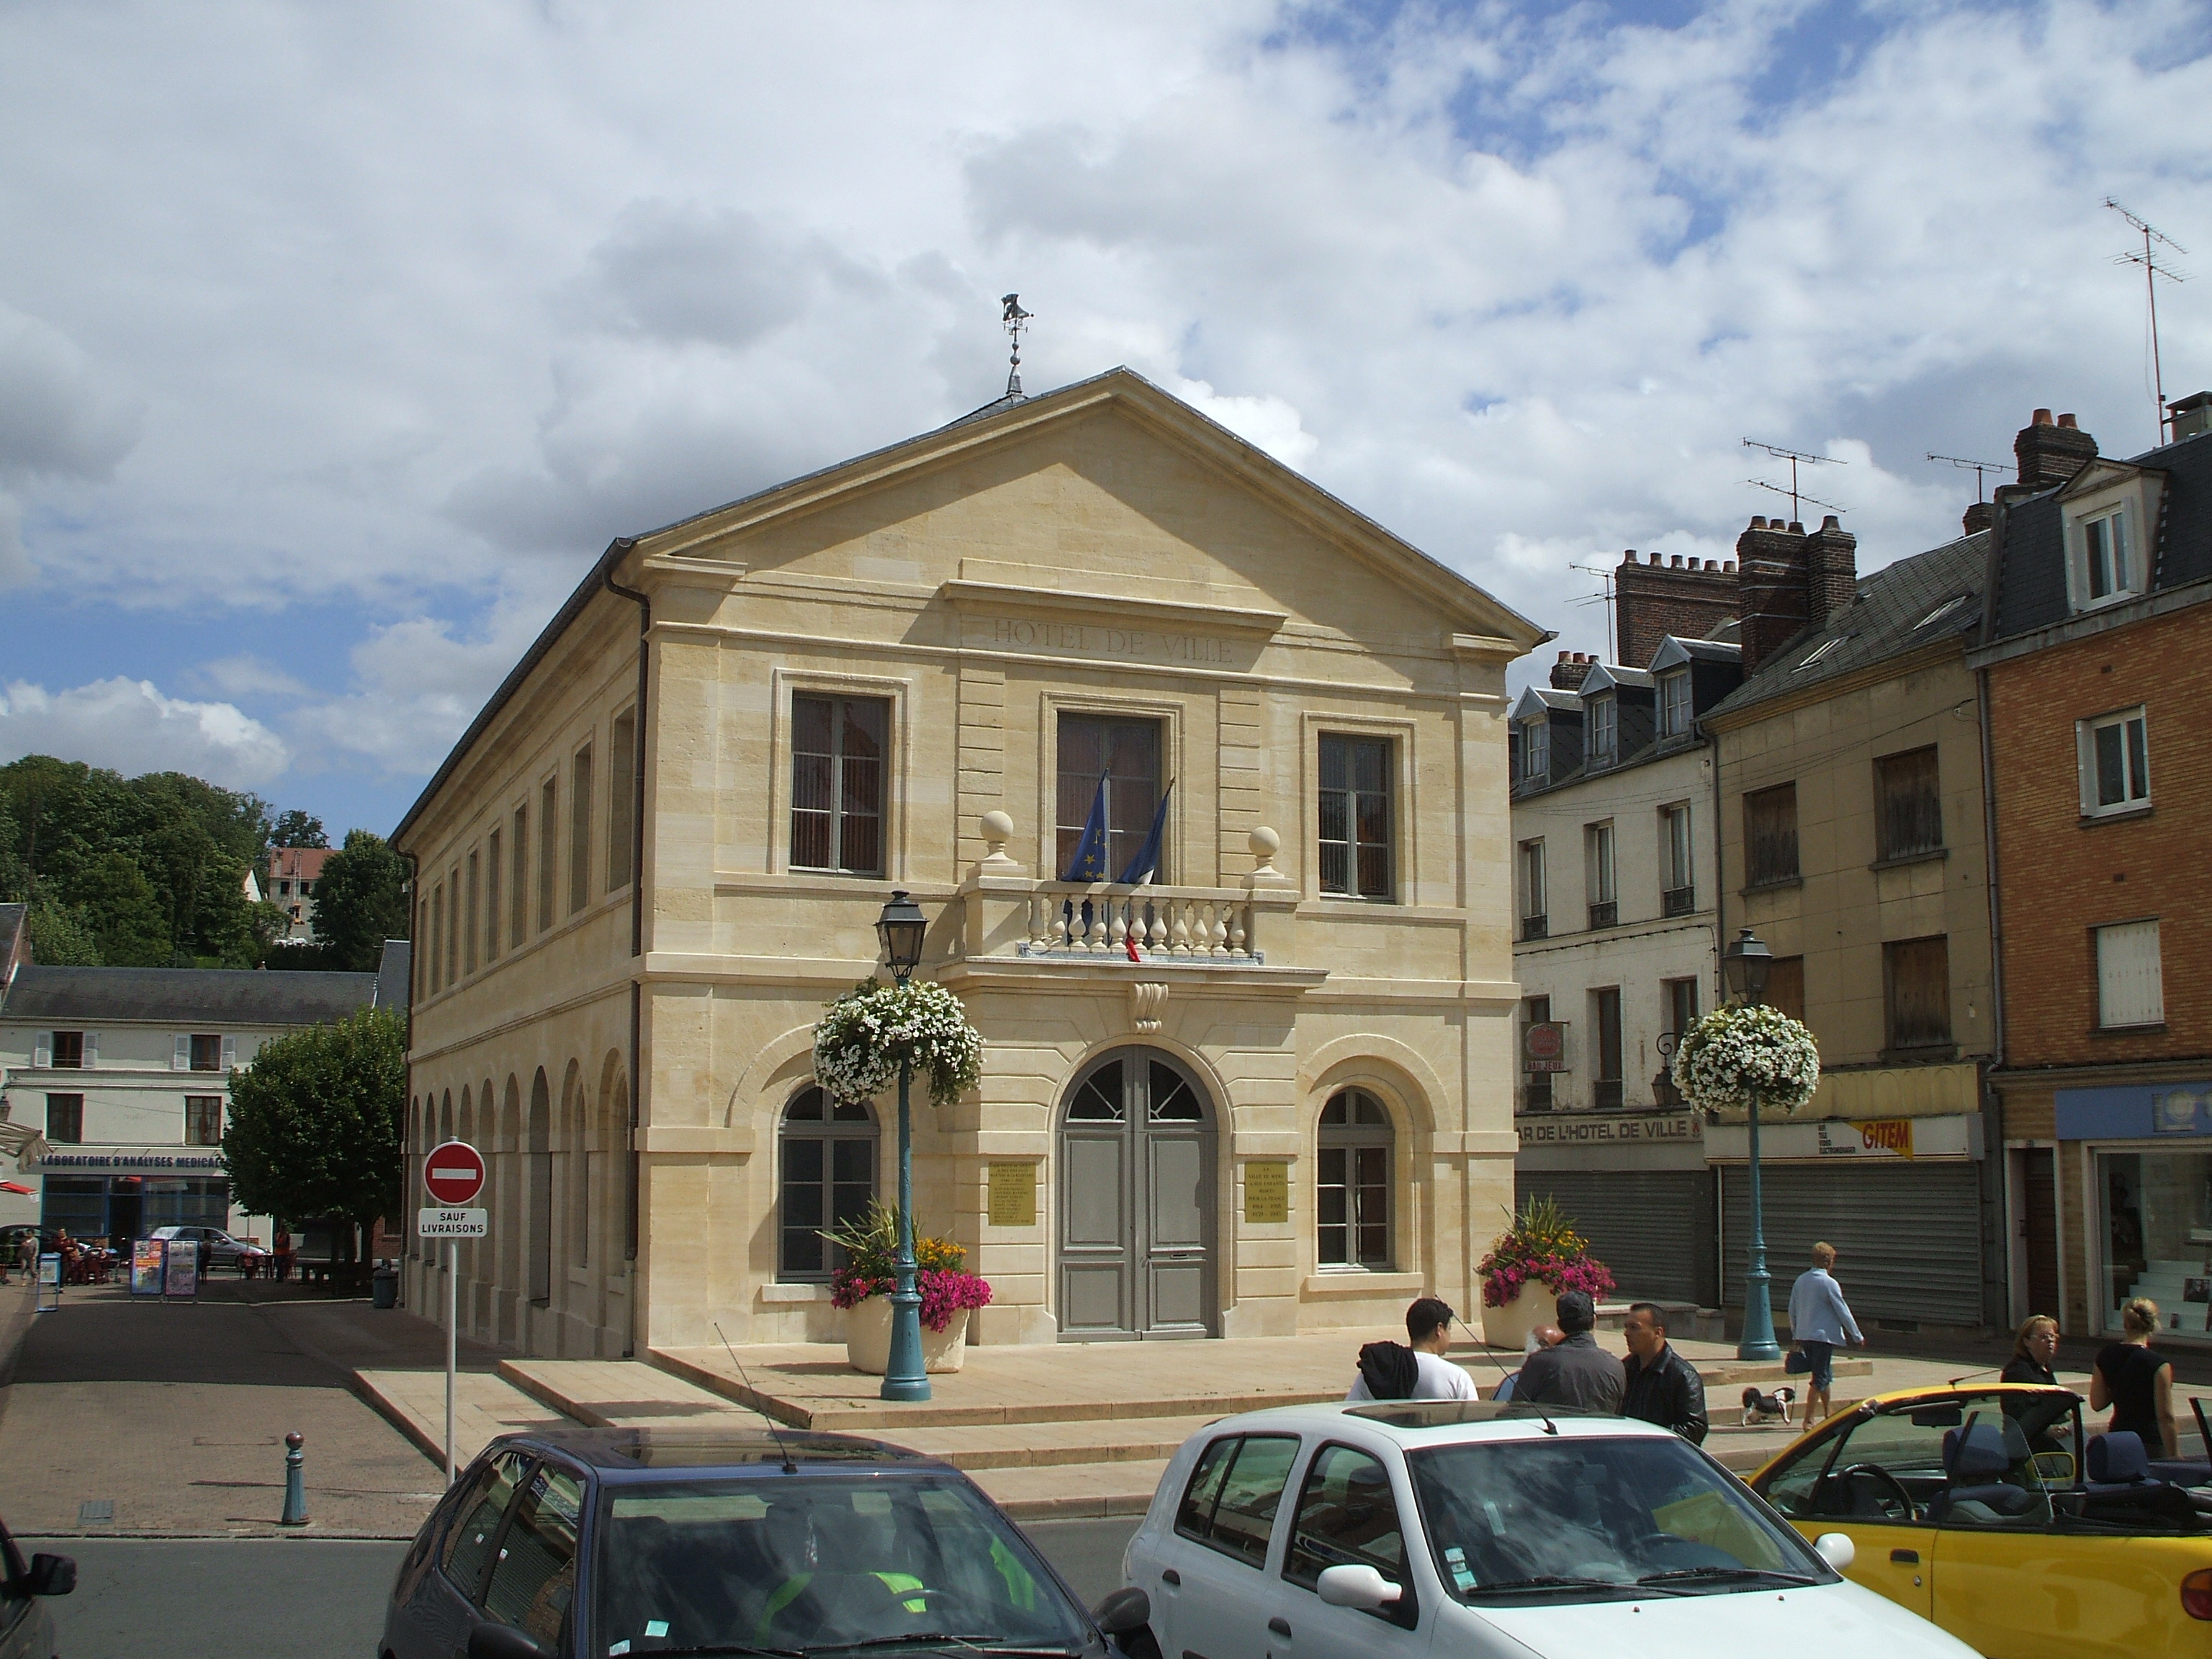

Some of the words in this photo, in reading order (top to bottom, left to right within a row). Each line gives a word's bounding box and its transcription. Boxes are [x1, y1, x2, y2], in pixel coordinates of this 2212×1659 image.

[994, 619, 1091, 649] HOTEL
[1107, 630, 1144, 655] DE
[1162, 634, 1233, 663] VILLE
[1516, 1126, 1533, 1141] AR
[1537, 1125, 1555, 1141] DE
[1558, 1123, 1615, 1141] L'HOTEL
[1619, 1122, 1640, 1138] DE
[1645, 1120, 1687, 1138] VILLE
[1862, 1121, 1909, 1150] GITEM
[41, 1154, 111, 1166] LABORATOIRE
[114, 1156, 173, 1167] D'ANALYSES
[176, 1157, 229, 1167] MEDICAL
[440, 1213, 467, 1221] SAUF
[422, 1224, 484, 1233] LIVRAISONS
